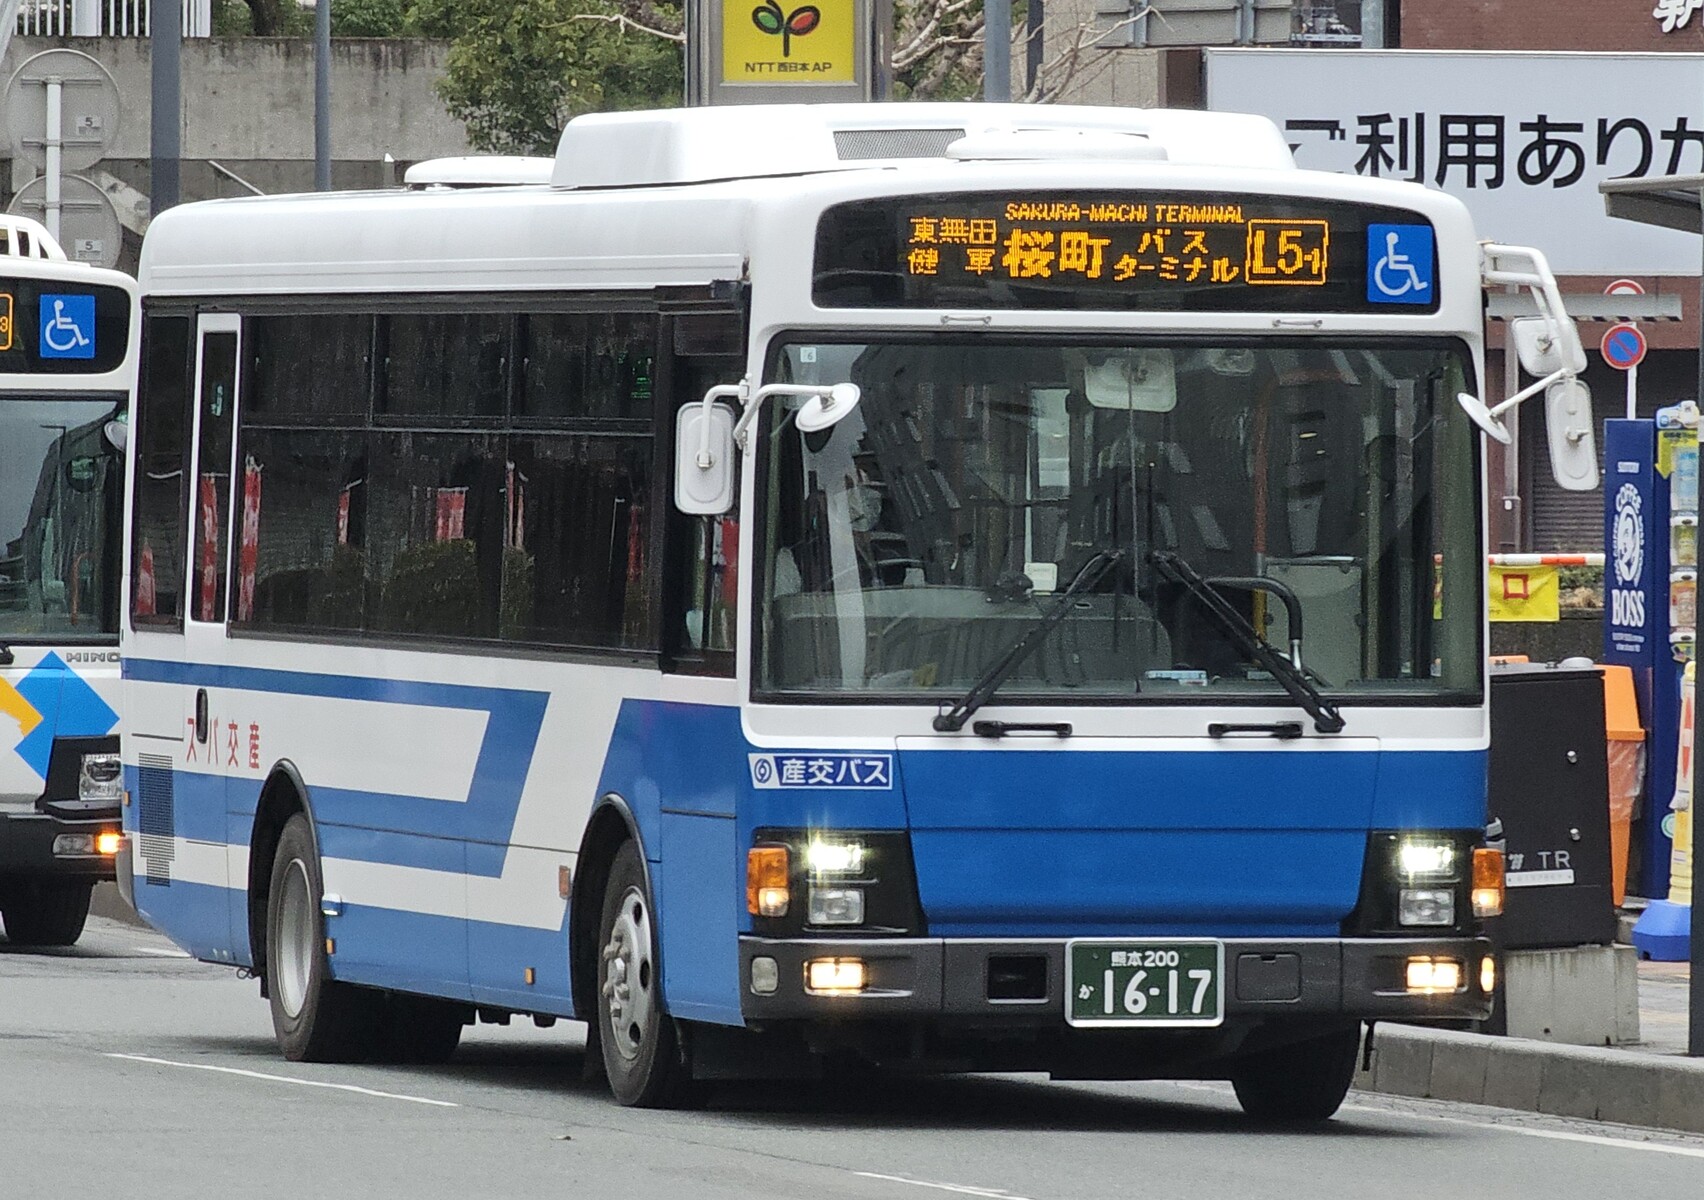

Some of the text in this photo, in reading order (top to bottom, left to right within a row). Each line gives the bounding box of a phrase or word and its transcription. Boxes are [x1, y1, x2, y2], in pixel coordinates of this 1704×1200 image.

[85, 116, 93, 127] 5
[1005, 203, 1244, 223] SAKURA-MACHI TERMINAL
[909, 217, 996, 244] 東無田
[85, 241, 93, 250] 5
[1002, 228, 1111, 278] 桜町
[1114, 253, 1239, 282] ターミナル
[1612, 589, 1645, 627] BOSS
[66, 652, 120, 662] HINO
[781, 758, 888, 784] 産交バス
[1537, 850, 1571, 869] TR
[1078, 969, 1212, 1014] か 16-17
